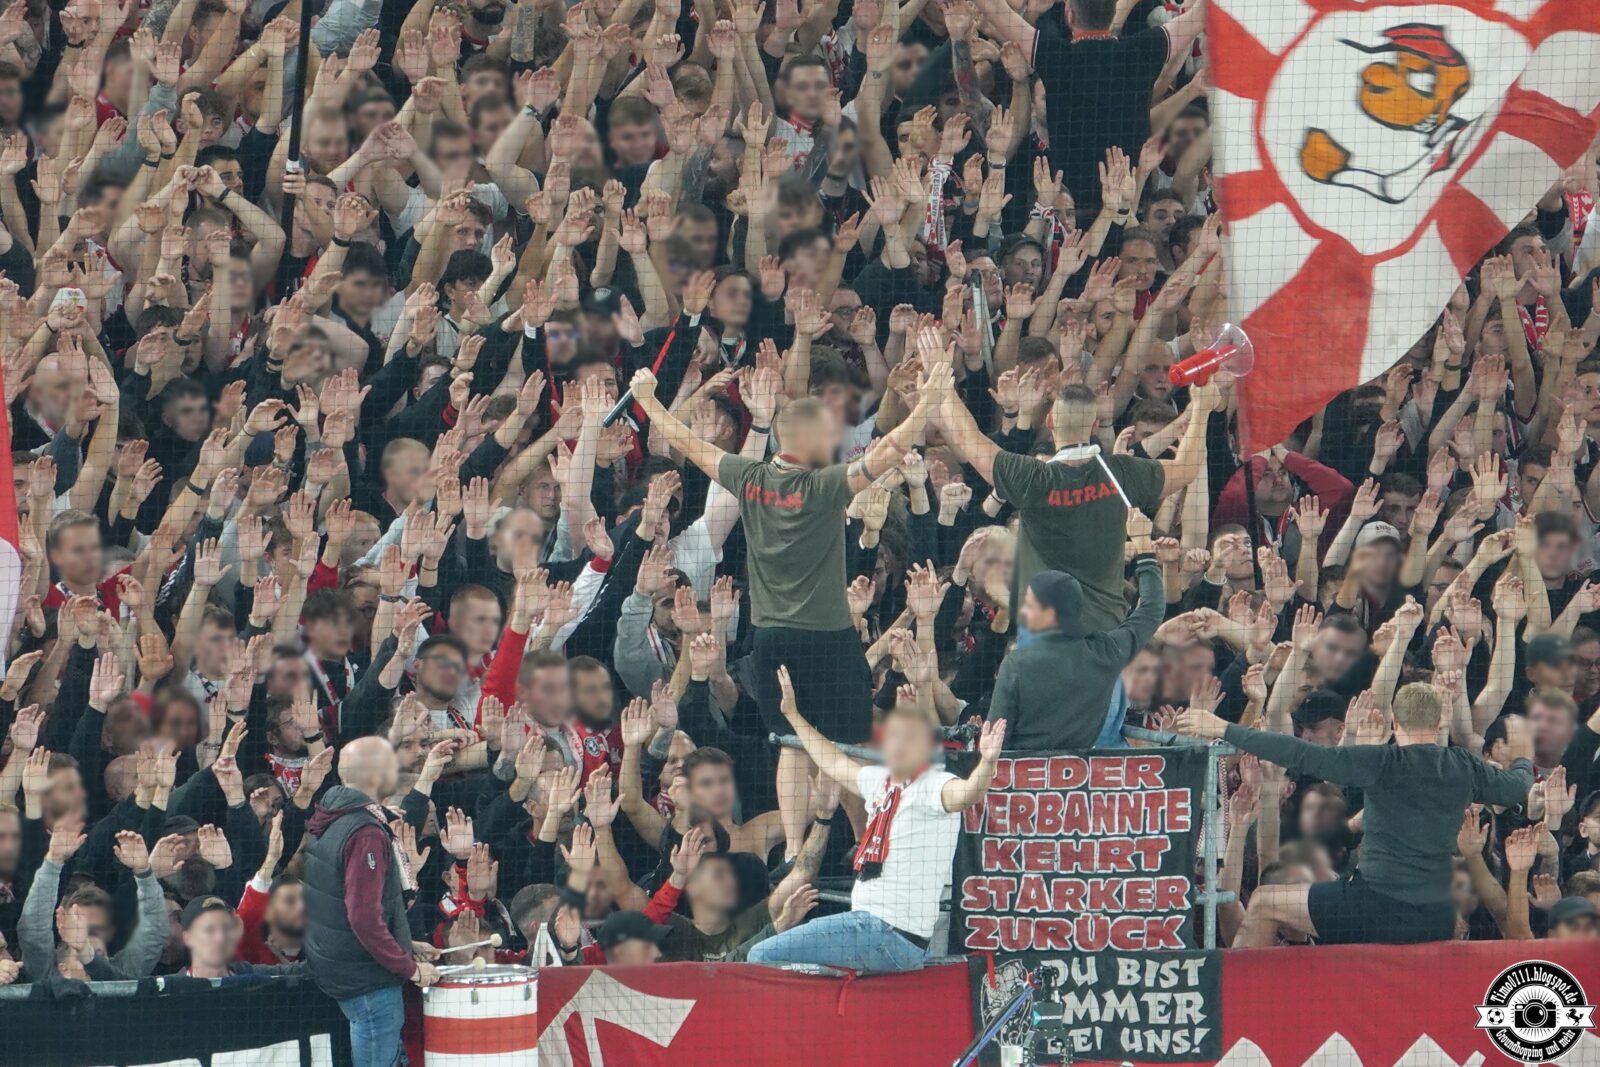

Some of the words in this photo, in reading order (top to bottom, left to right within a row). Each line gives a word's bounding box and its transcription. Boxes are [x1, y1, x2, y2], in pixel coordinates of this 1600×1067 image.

[963, 788, 1191, 836] VERBANNTE
[982, 835, 1171, 873] KEHRT
[965, 913, 1186, 951] ZURÜCK
[1116, 957, 1207, 988] BIST
[1062, 989, 1207, 1025] MMER
[1048, 1026, 1103, 1054] EI
[1120, 1027, 1211, 1055] UNS!
